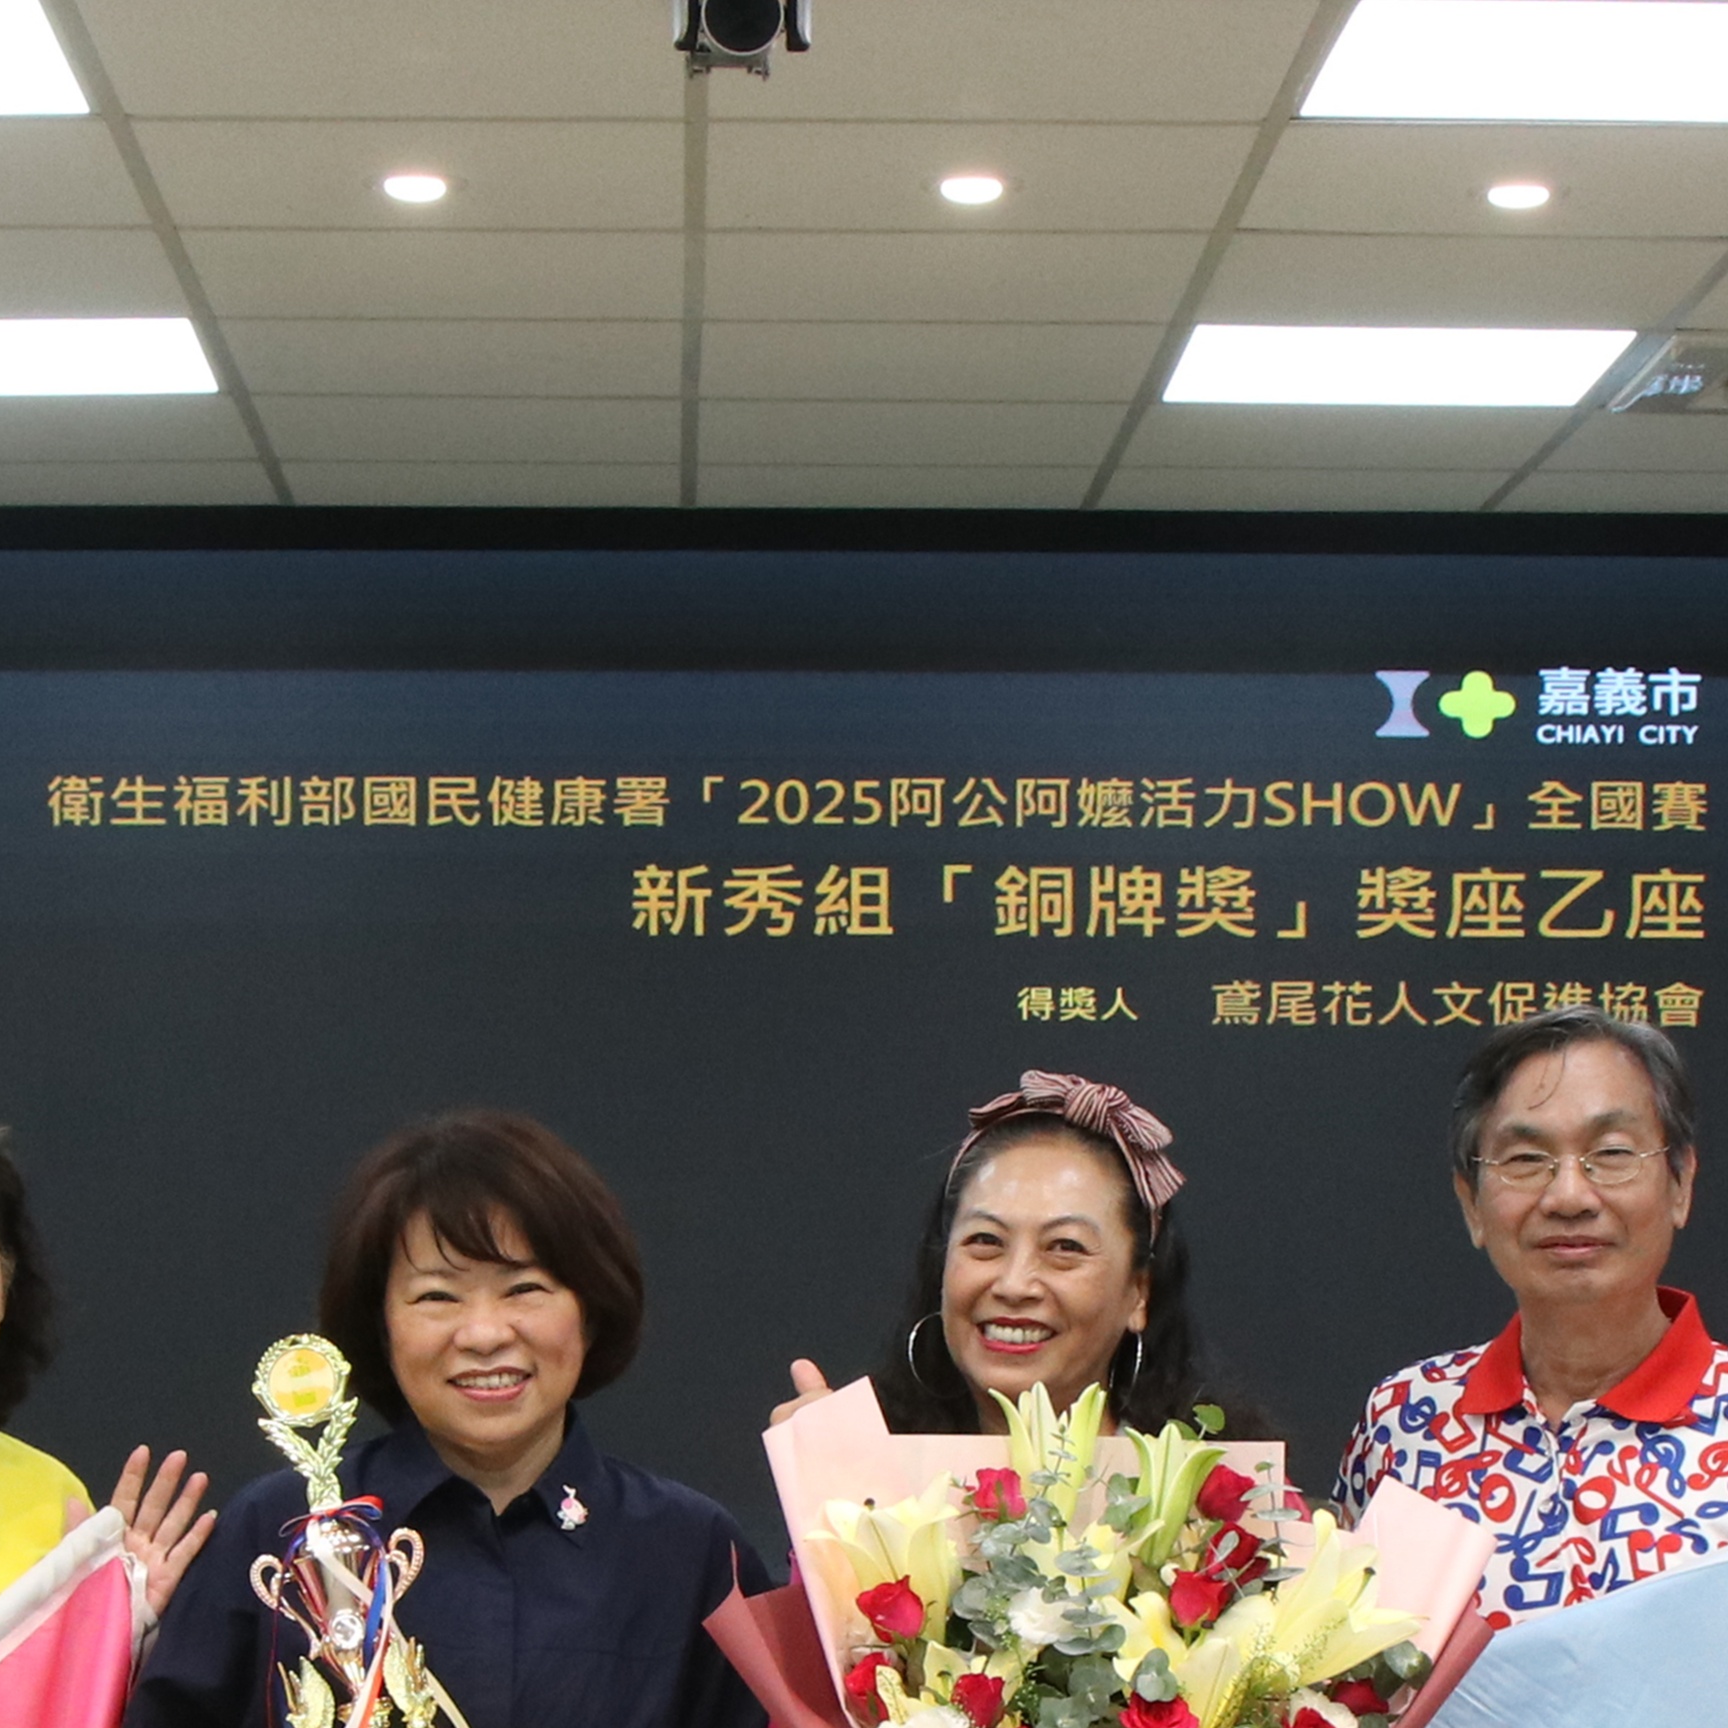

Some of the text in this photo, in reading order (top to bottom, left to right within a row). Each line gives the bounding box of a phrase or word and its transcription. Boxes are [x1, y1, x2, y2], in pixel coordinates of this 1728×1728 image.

[1537, 666, 1703, 717] 嘉義市
[1535, 723, 1700, 746] CHIAYI CITY
[46, 774, 1708, 832] 衛生福利部國民健康署「2025阿公阿嬤活力SHOW」全國賽
[631, 863, 1707, 940] 新秀組「銅牌獎」獎座乙座
[1017, 980, 1705, 1027] 得獎人 鳶尾花人文促進協會
